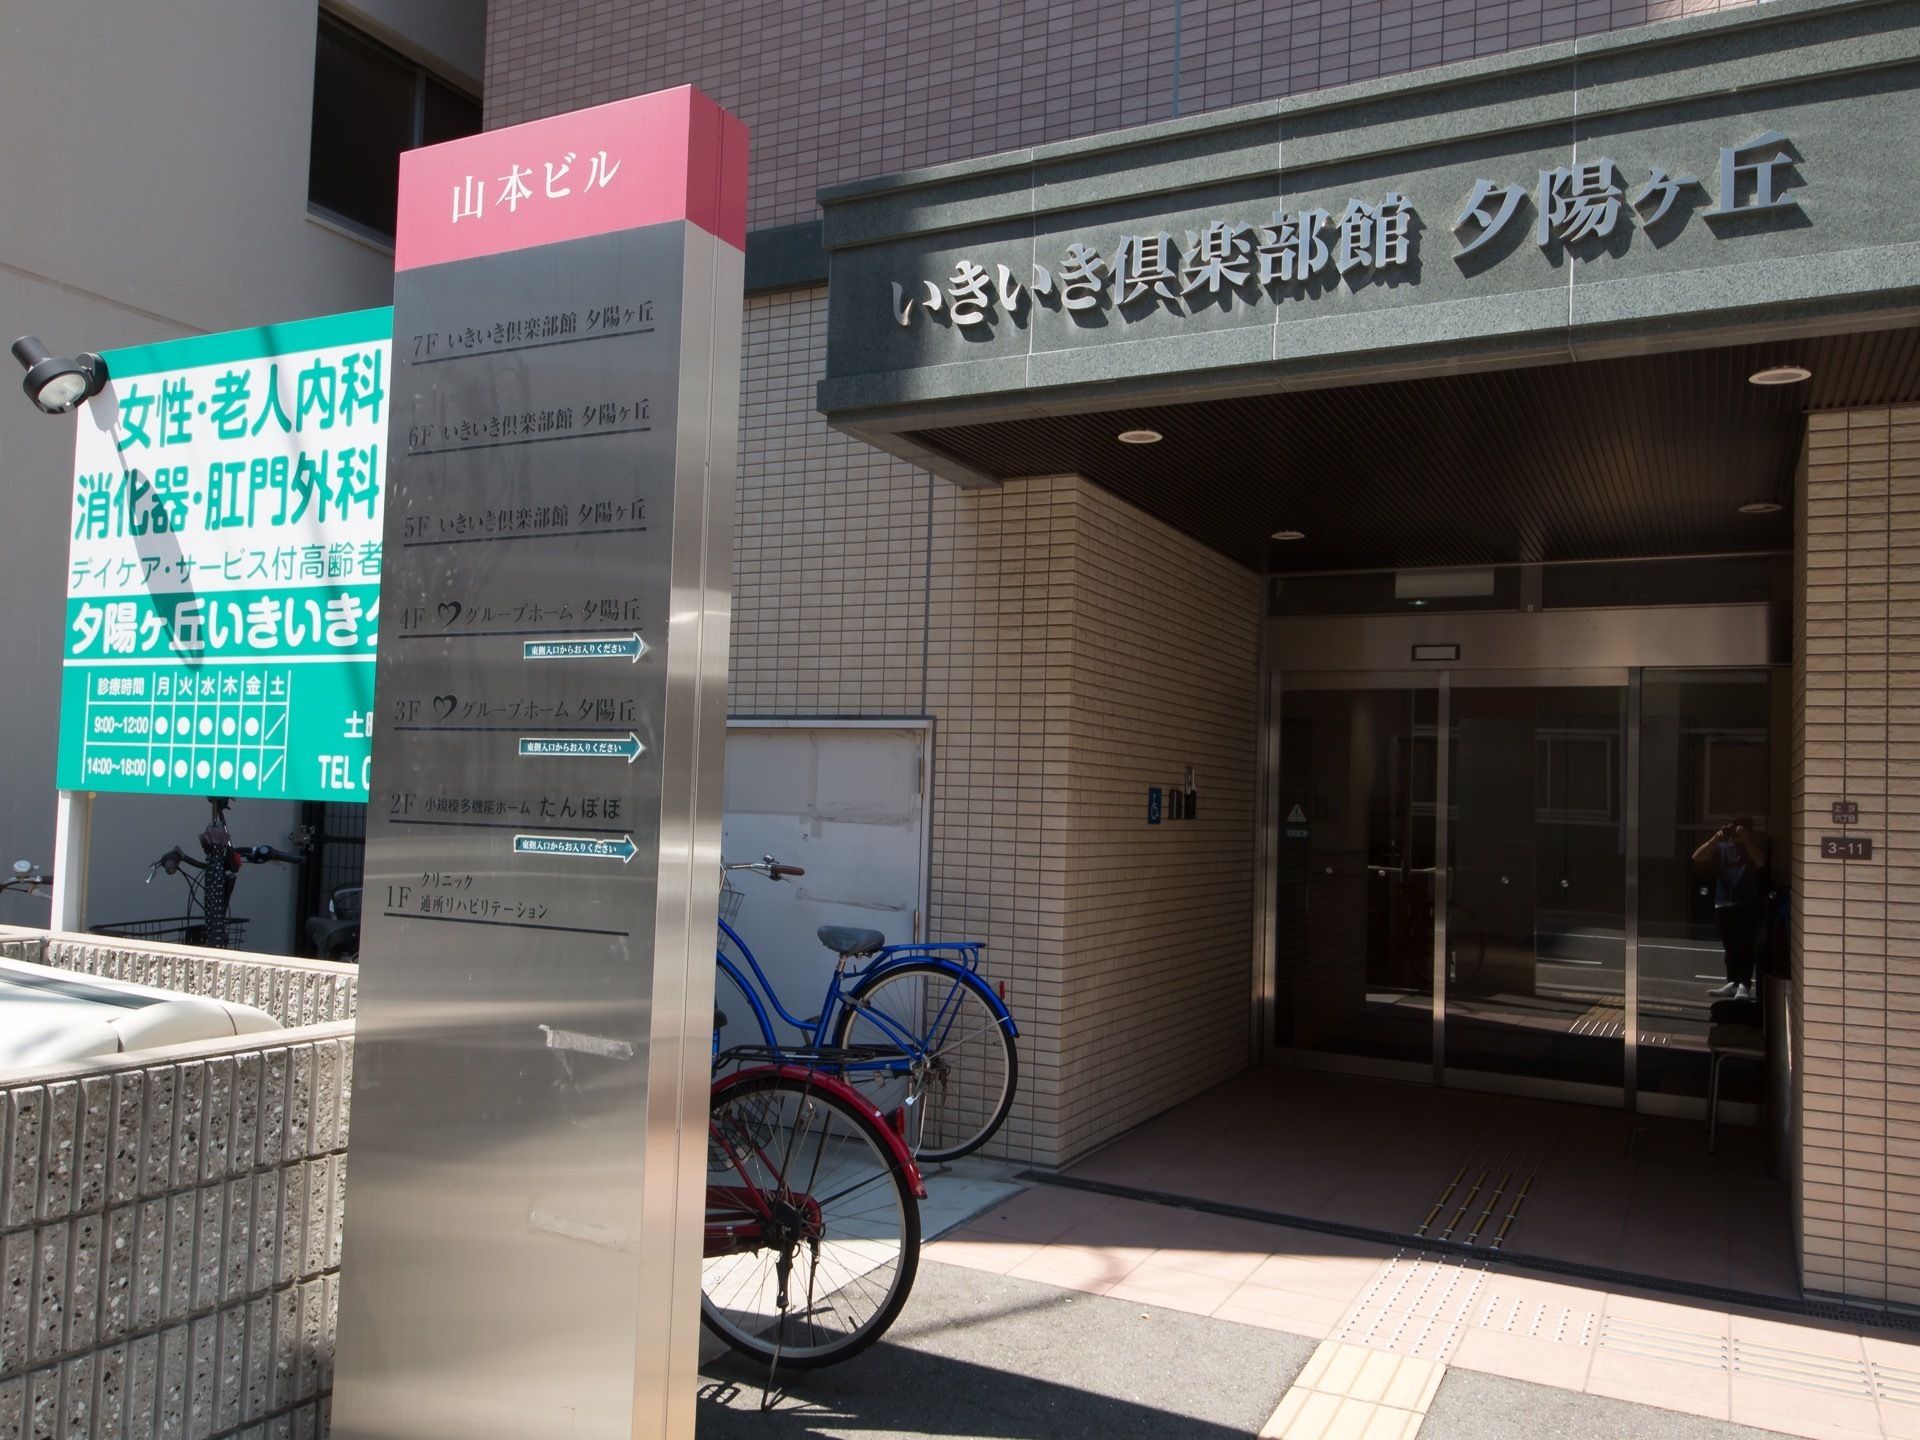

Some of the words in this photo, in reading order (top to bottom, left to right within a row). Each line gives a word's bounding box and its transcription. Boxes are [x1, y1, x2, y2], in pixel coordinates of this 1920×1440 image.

[452, 150, 622, 224] 山本ビル
[890, 191, 1416, 329] いきいき倶楽部館
[413, 332, 439, 357] 7F
[448, 311, 577, 350] いきいき倶楽部館
[117, 348, 384, 452] 女性・老人内科
[408, 424, 434, 448] 6F
[443, 408, 573, 441] いきいき倶楽部館
[74, 443, 380, 541] 消化器・肛門外科
[404, 515, 430, 538] 5F
[439, 505, 569, 534] いきいき倶楽部館
[400, 607, 426, 629] 4F
[466, 602, 573, 625] グループホーム
[581, 598, 641, 623] 夕陽丘
[531, 643, 626, 656] 東側入口からお入りください
[97, 677, 145, 697] 診療時間
[156, 676, 170, 696] 月
[179, 676, 193, 696] 火
[200, 676, 215, 696] 水
[222, 676, 238, 696] 木
[245, 675, 261, 696] 金
[270, 675, 285, 695] 土
[394, 700, 421, 721] 3F
[462, 698, 569, 720] グループホーム
[578, 698, 637, 722] 夕陽丘
[527, 742, 622, 754] 東側入口からお入りください
[318, 755, 355, 790] TEL
[390, 793, 417, 815] 2F
[424, 797, 531, 816] 小規模多機能ホーム
[539, 797, 622, 820] たんぽぽ
[522, 839, 617, 854] 東側入口からお入りください
[1828, 842, 1863, 856] 3-11
[420, 871, 473, 890] クリニック
[386, 885, 412, 909] 1F
[420, 894, 550, 920] 通所リハビリテーション
